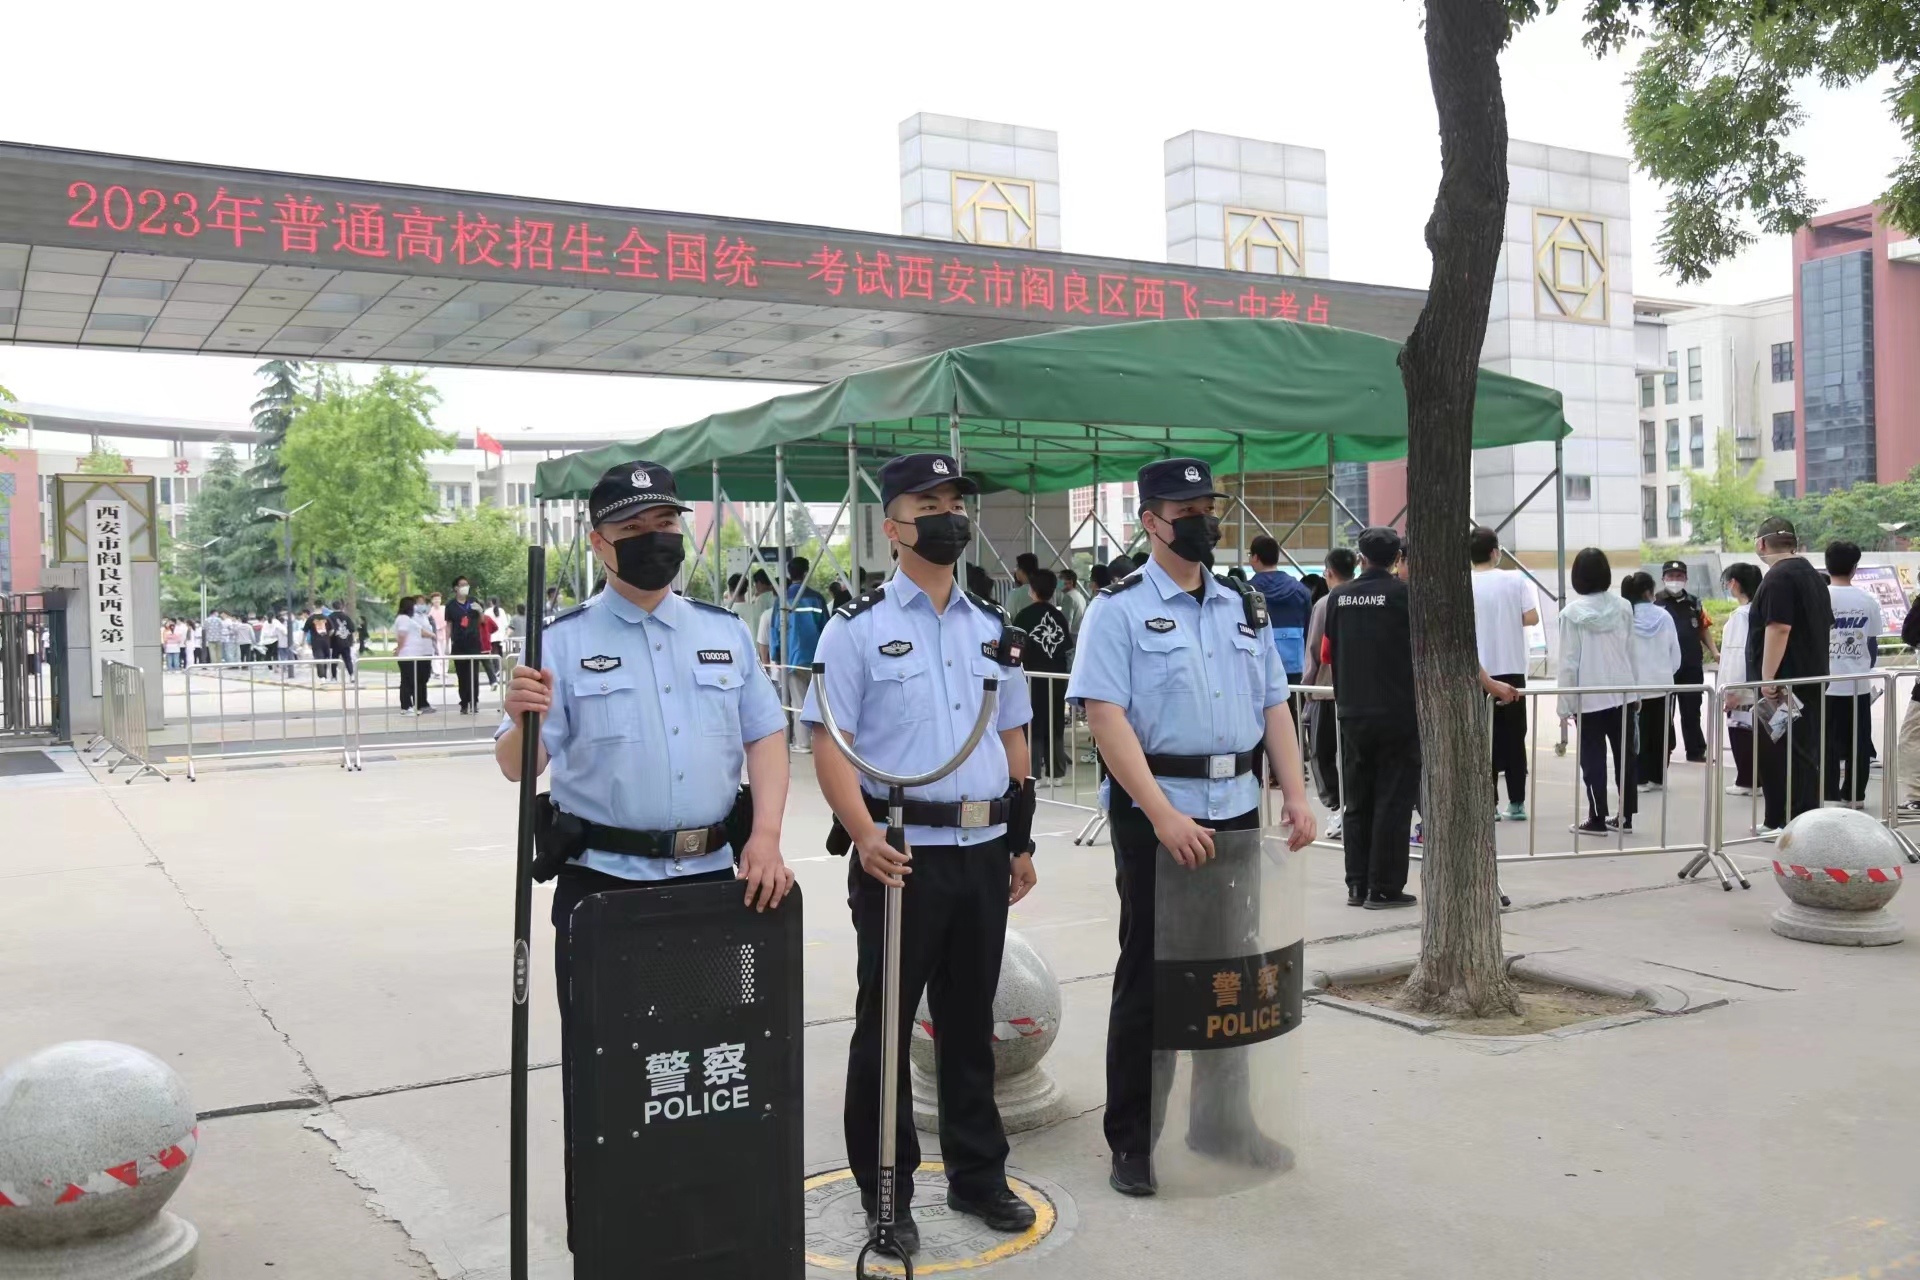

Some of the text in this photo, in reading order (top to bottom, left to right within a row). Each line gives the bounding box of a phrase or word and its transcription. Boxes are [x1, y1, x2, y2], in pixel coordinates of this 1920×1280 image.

[1212, 963, 1280, 1008] 警察
[1206, 1003, 1281, 1039] POLICE
[645, 1042, 748, 1097] 警察
[644, 1085, 750, 1124] POLICE
